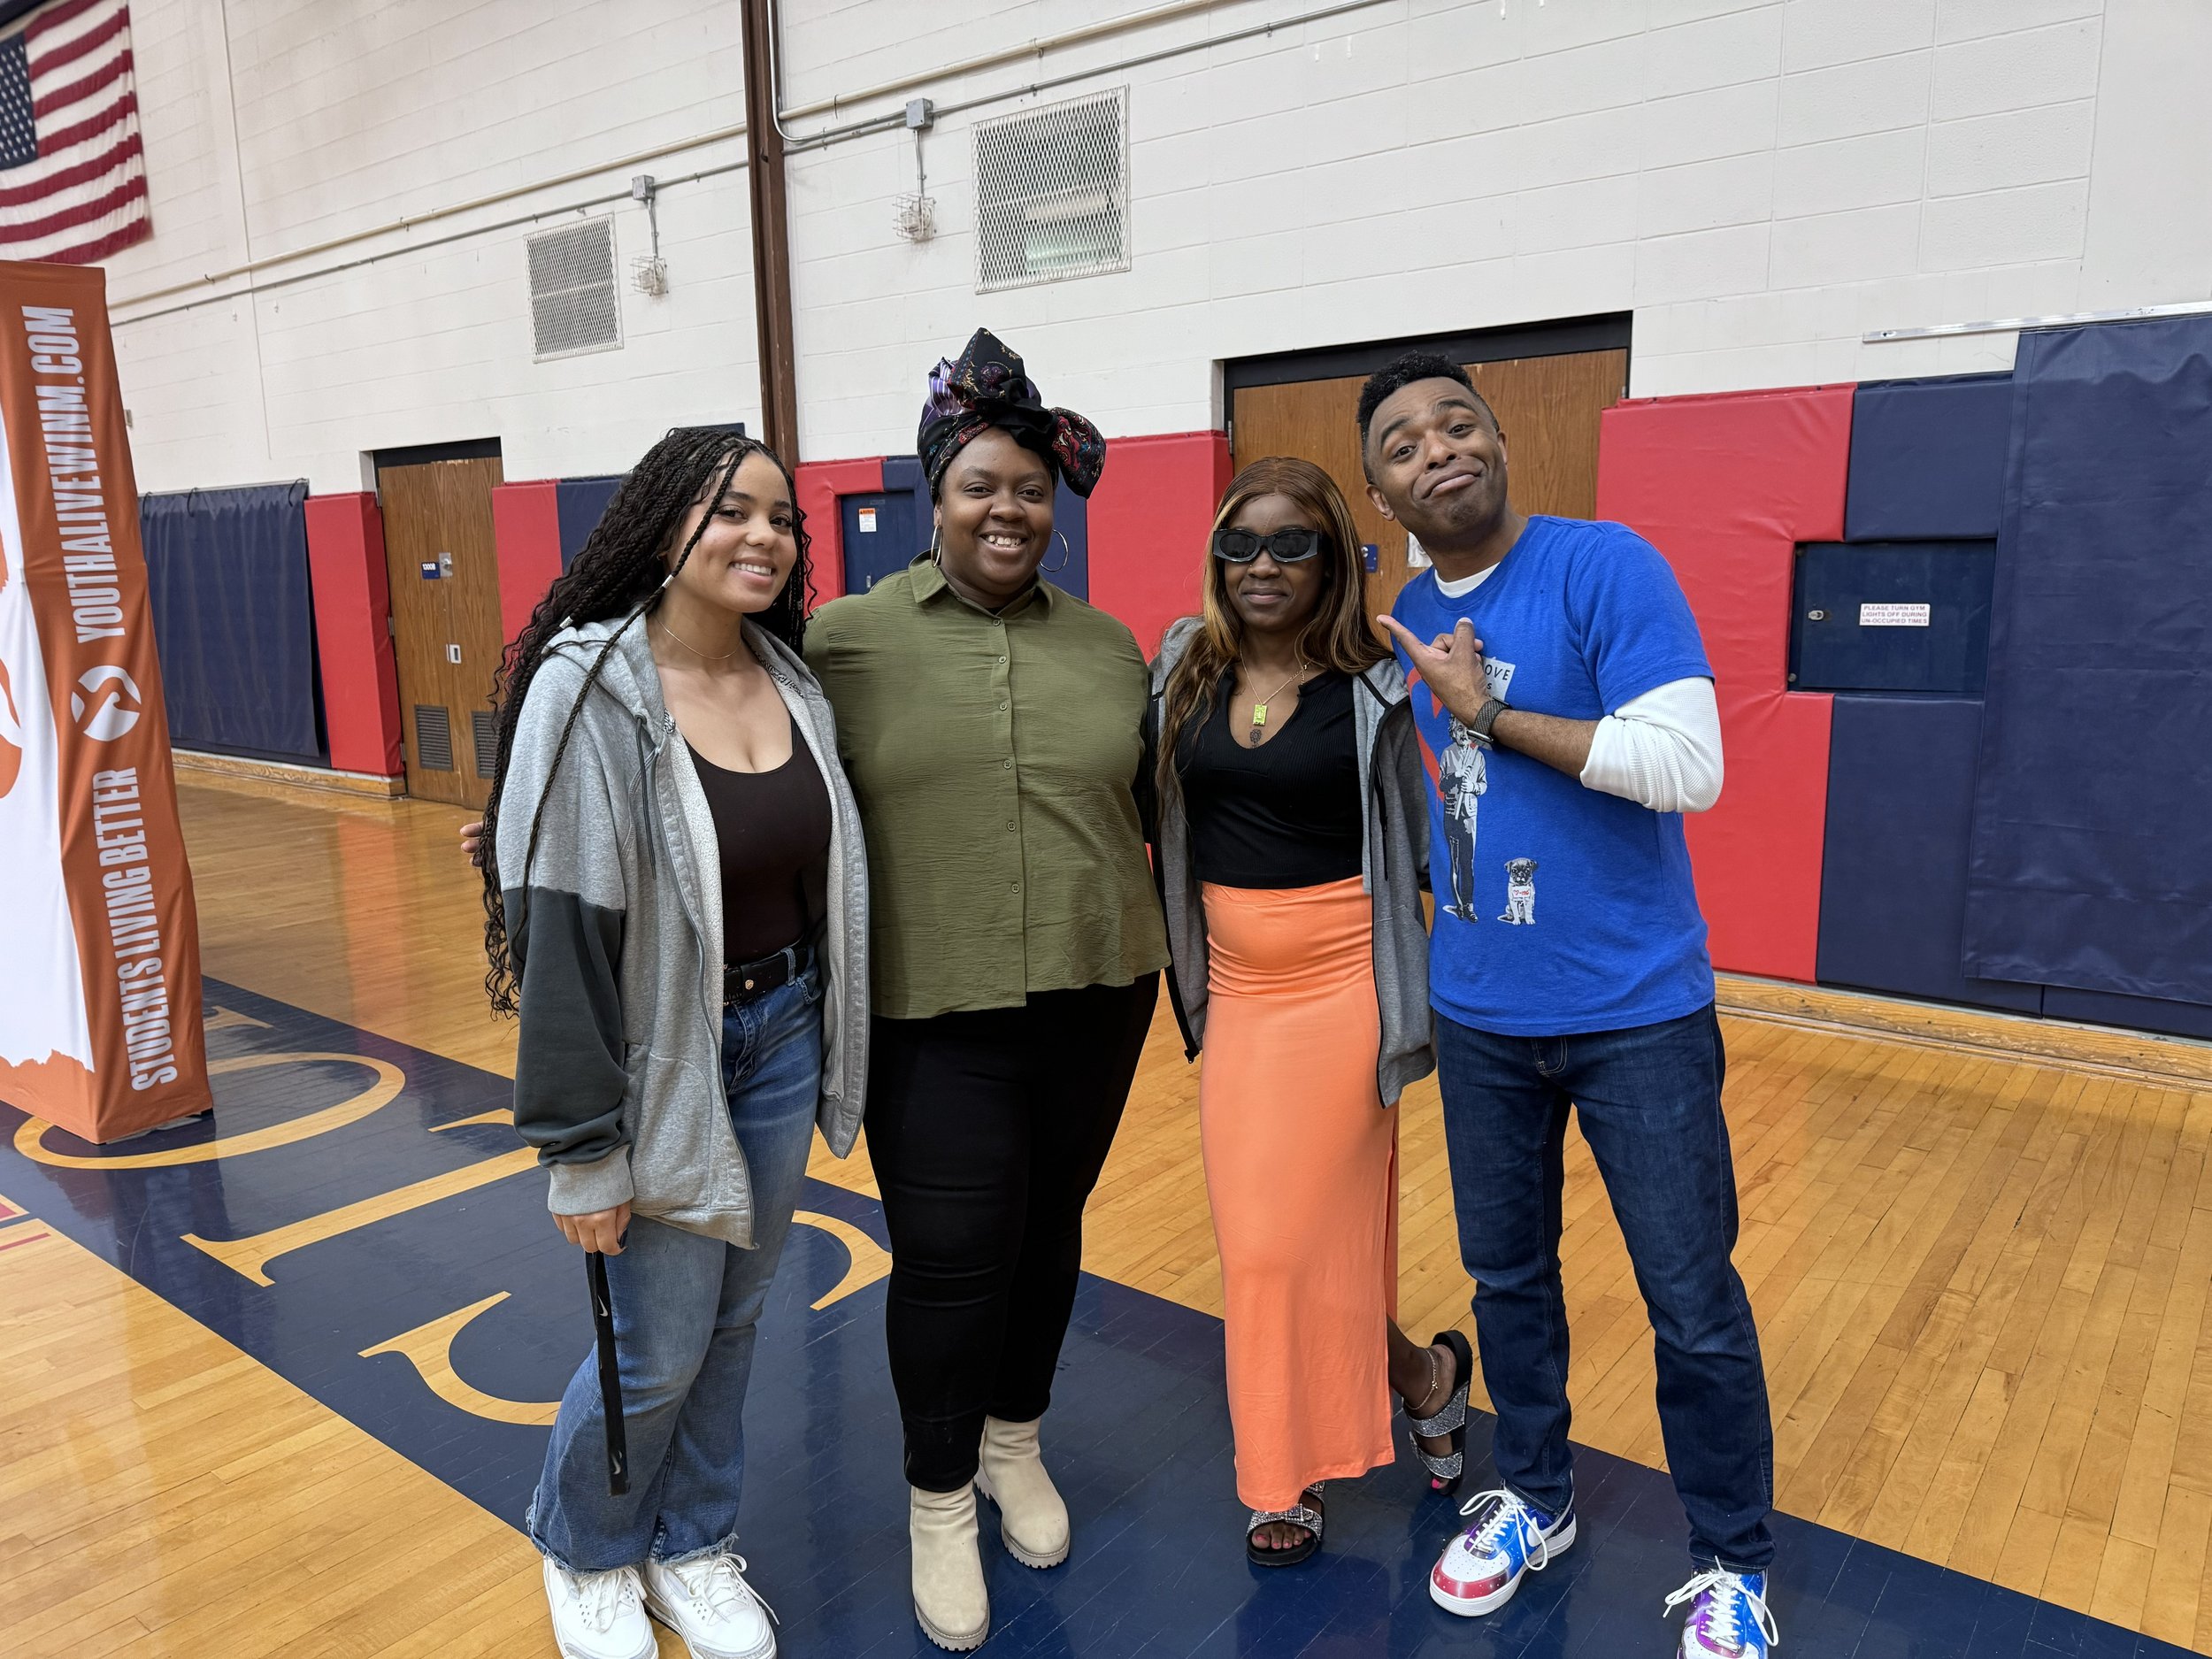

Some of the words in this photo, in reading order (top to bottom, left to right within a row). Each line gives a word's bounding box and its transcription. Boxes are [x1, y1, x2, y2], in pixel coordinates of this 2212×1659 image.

[21, 305, 125, 643] YOUTHALIVEWINM.COM
[93, 766, 149, 867] BETTER
[102, 865, 160, 959] LIVING
[117, 956, 178, 1091] STUDENTS
